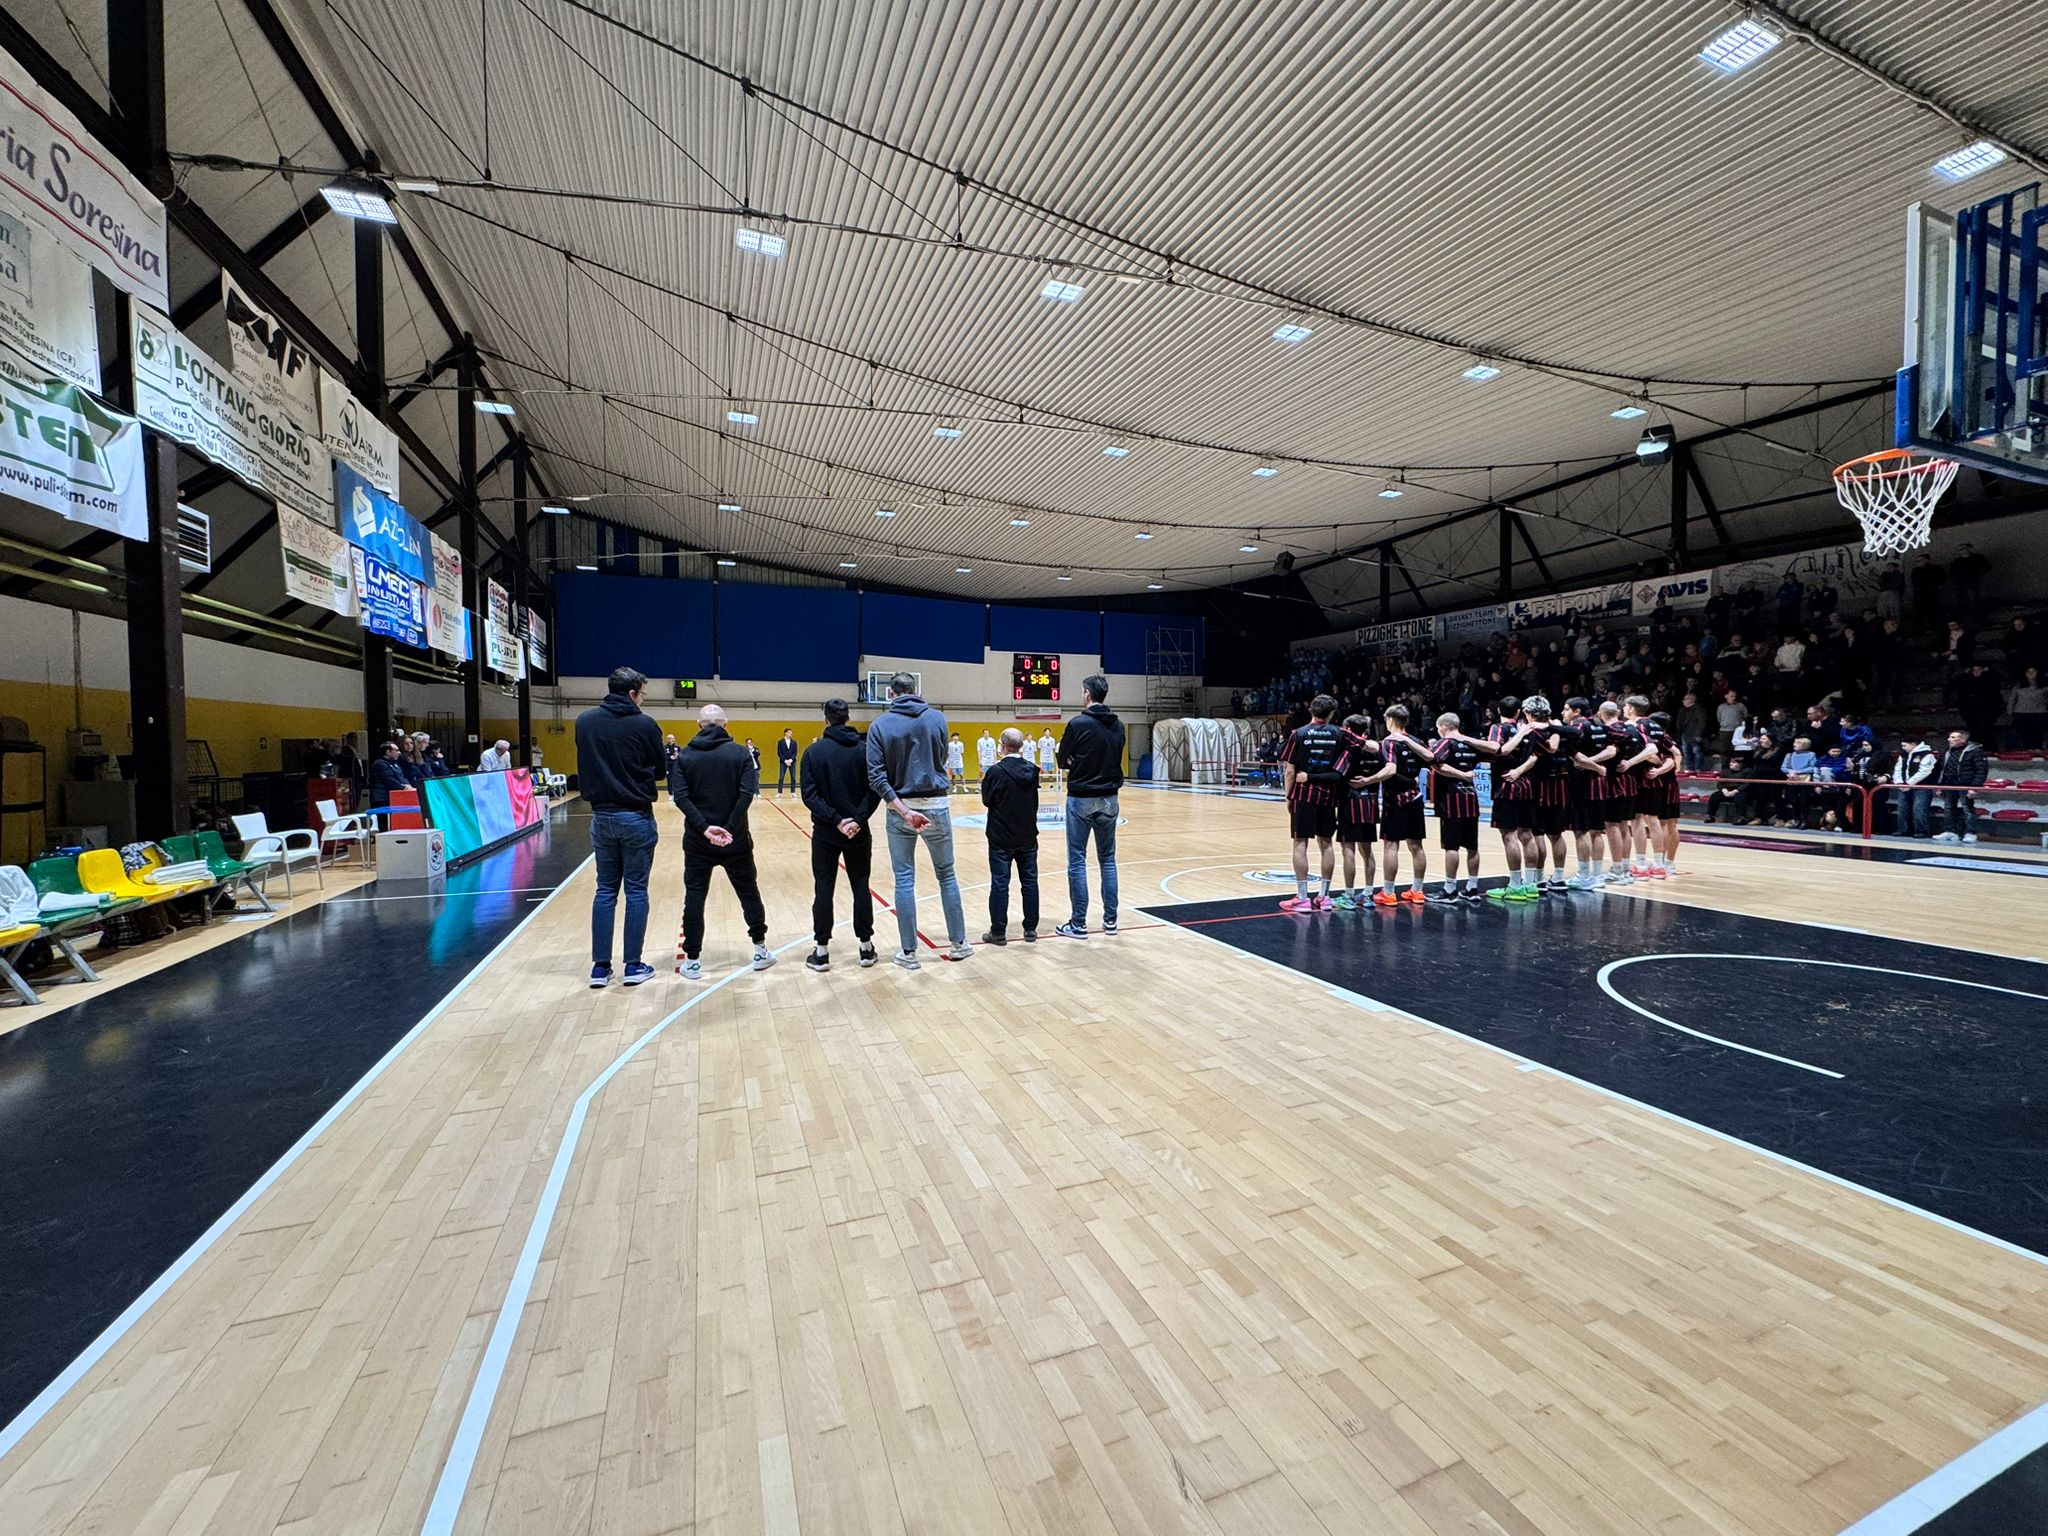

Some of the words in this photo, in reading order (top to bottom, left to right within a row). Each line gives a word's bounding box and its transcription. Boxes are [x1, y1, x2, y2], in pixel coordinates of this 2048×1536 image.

[44, 142, 162, 278] Soresina
[174, 344, 256, 425] L'OTTAVO
[1657, 578, 1709, 600] AVIS
[1357, 617, 1433, 643] PIZZIGHETTONE
[1024, 659, 1030, 669] 0
[1051, 660, 1057, 670] 0
[1030, 674, 1049, 685] 5:36
[1016, 689, 1022, 699] 0
[1052, 690, 1057, 699] 0
